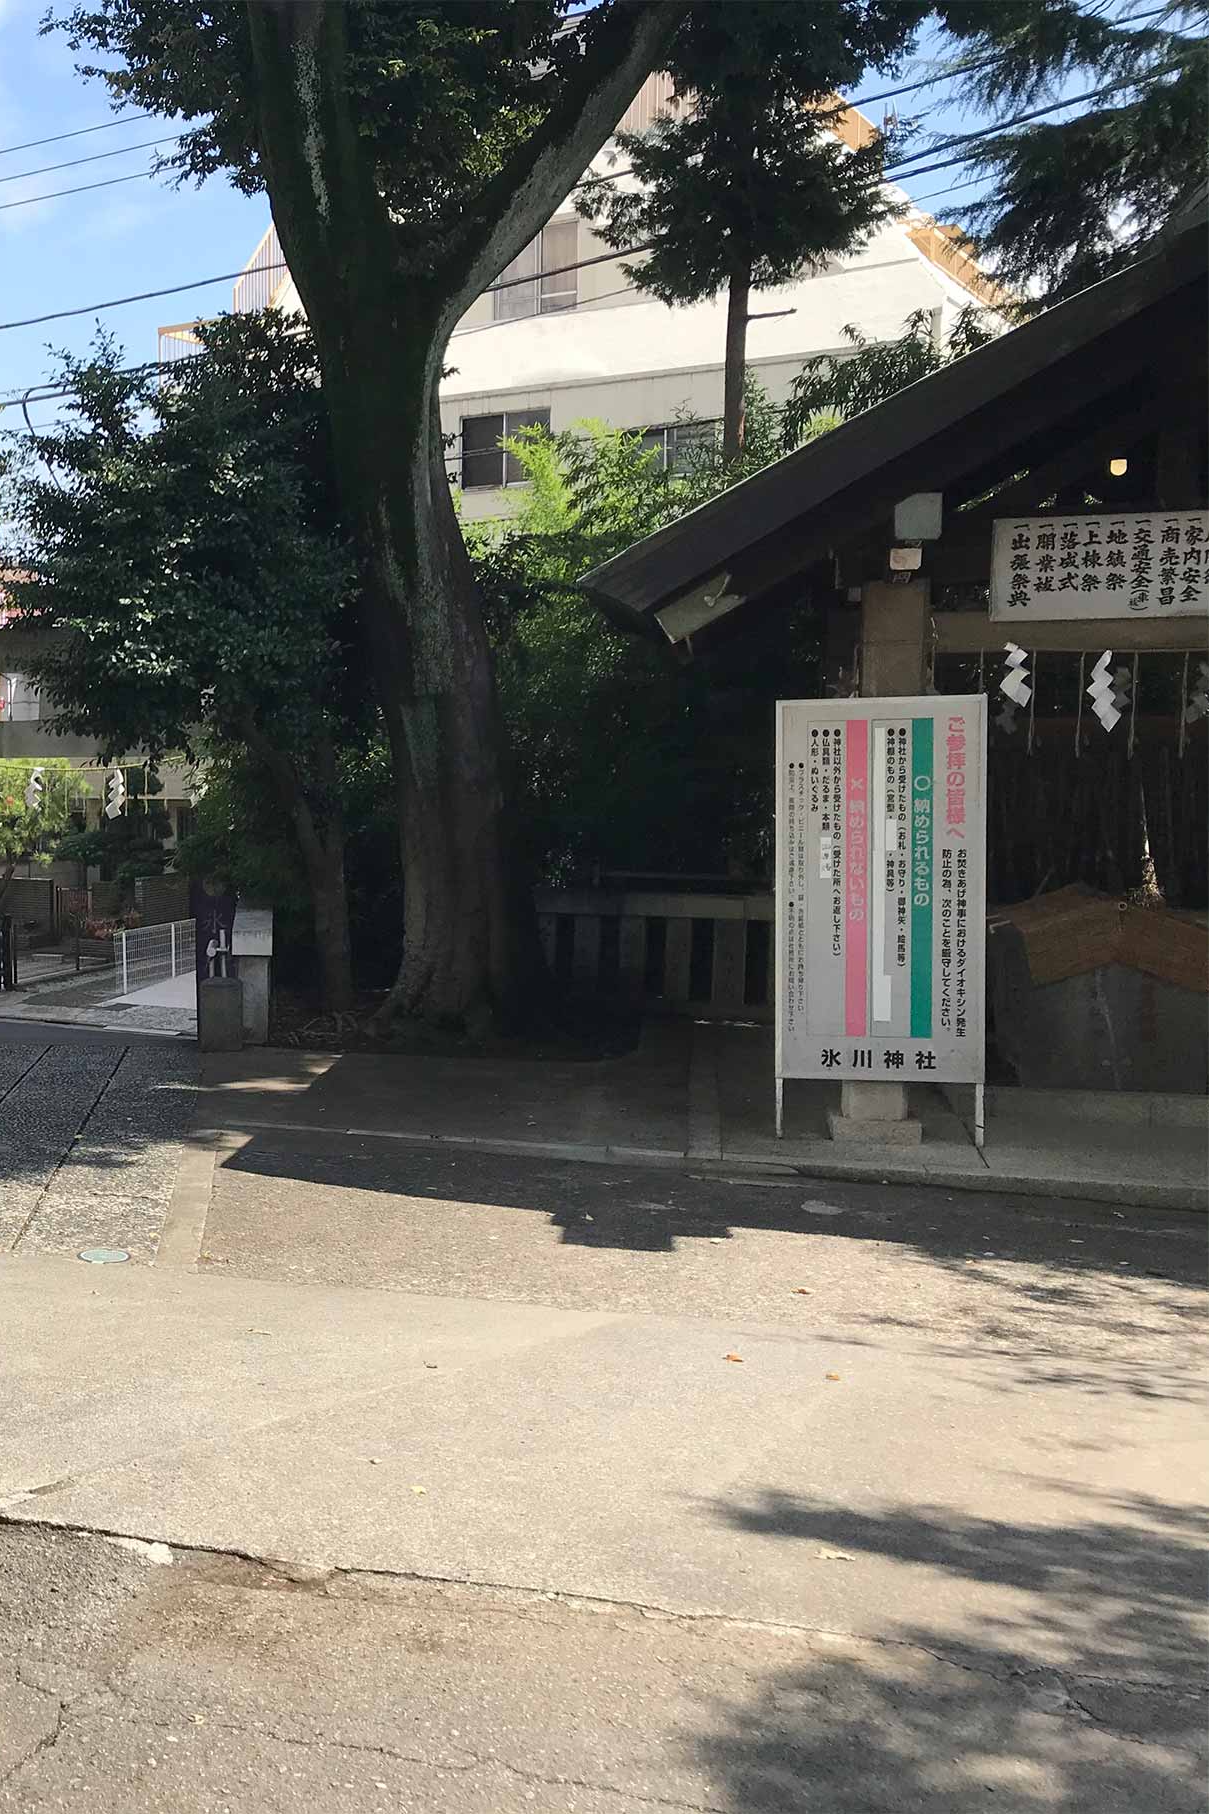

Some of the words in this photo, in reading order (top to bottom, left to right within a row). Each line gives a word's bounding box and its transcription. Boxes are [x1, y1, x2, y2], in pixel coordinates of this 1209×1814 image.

[946, 716, 966, 839] ご参拝の皆様へ
[821, 1048, 937, 1070] 氷川神社
